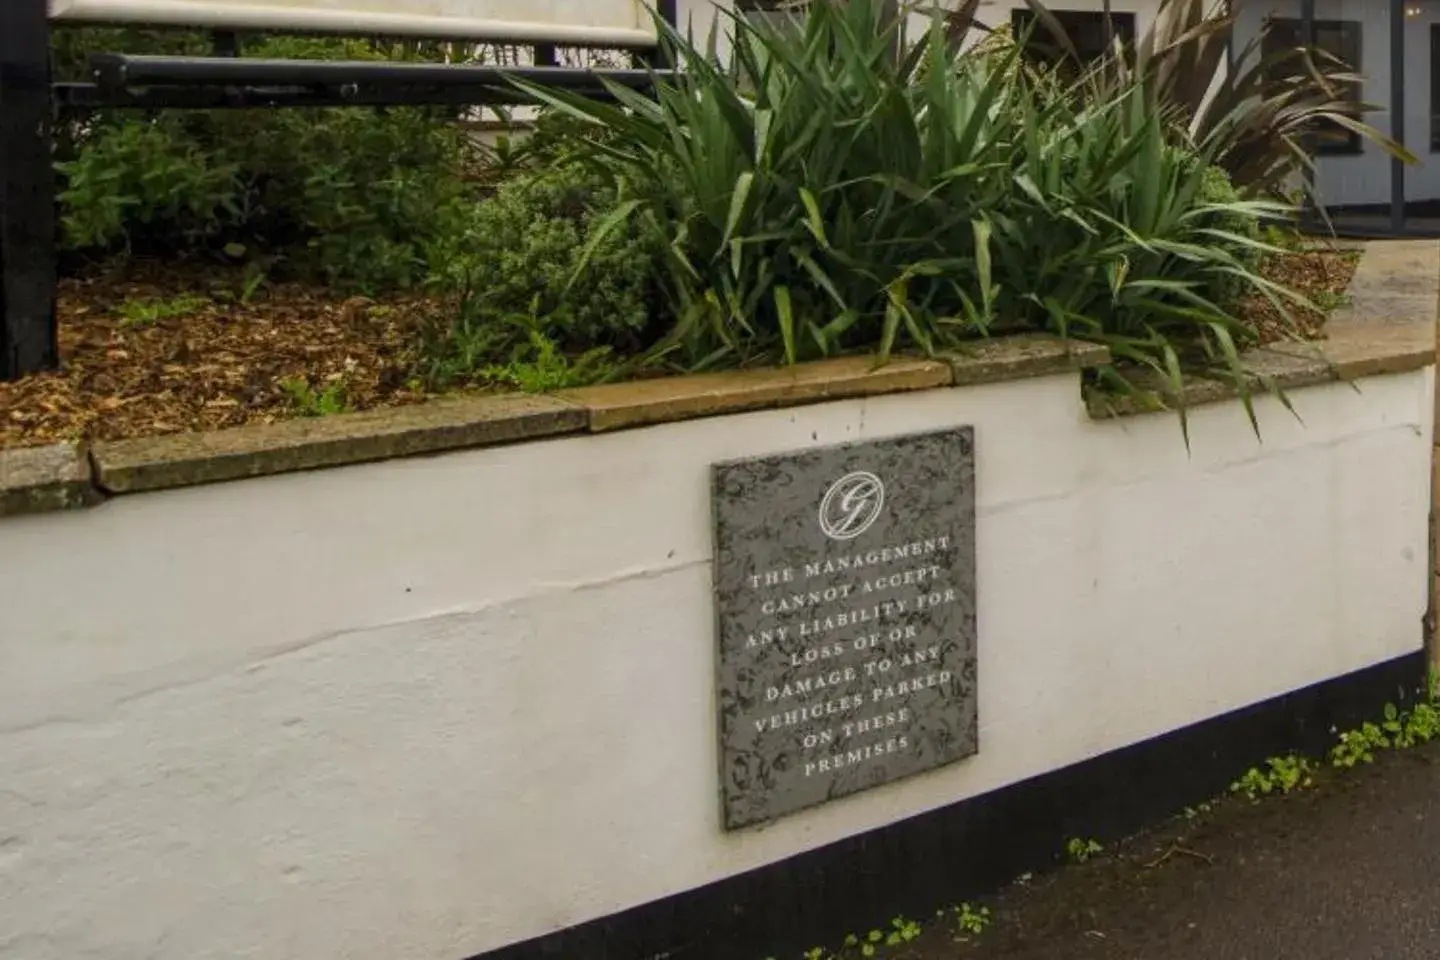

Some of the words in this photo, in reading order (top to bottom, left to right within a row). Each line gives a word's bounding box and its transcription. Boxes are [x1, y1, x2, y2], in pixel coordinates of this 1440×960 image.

[749, 568, 794, 589] THE
[805, 536, 950, 577] MANAGEMENT
[761, 584, 850, 615] CANNOT
[862, 565, 940, 593] ACCEPT
[745, 627, 789, 649] ANY
[799, 600, 907, 637] LIABILITY
[917, 589, 956, 609] FOR
[791, 644, 844, 668] LOSS
[853, 632, 881, 650] OF
[888, 624, 917, 642] OR
[766, 667, 856, 702] DAMAGE
[863, 658, 892, 677] TO
[900, 645, 940, 668] ANY
[754, 693, 864, 733] VEHICLES
[871, 671, 951, 702] PARKED
[803, 728, 834, 748] ON
[842, 707, 909, 738] THESE
[804, 736, 909, 777] PREMISES
